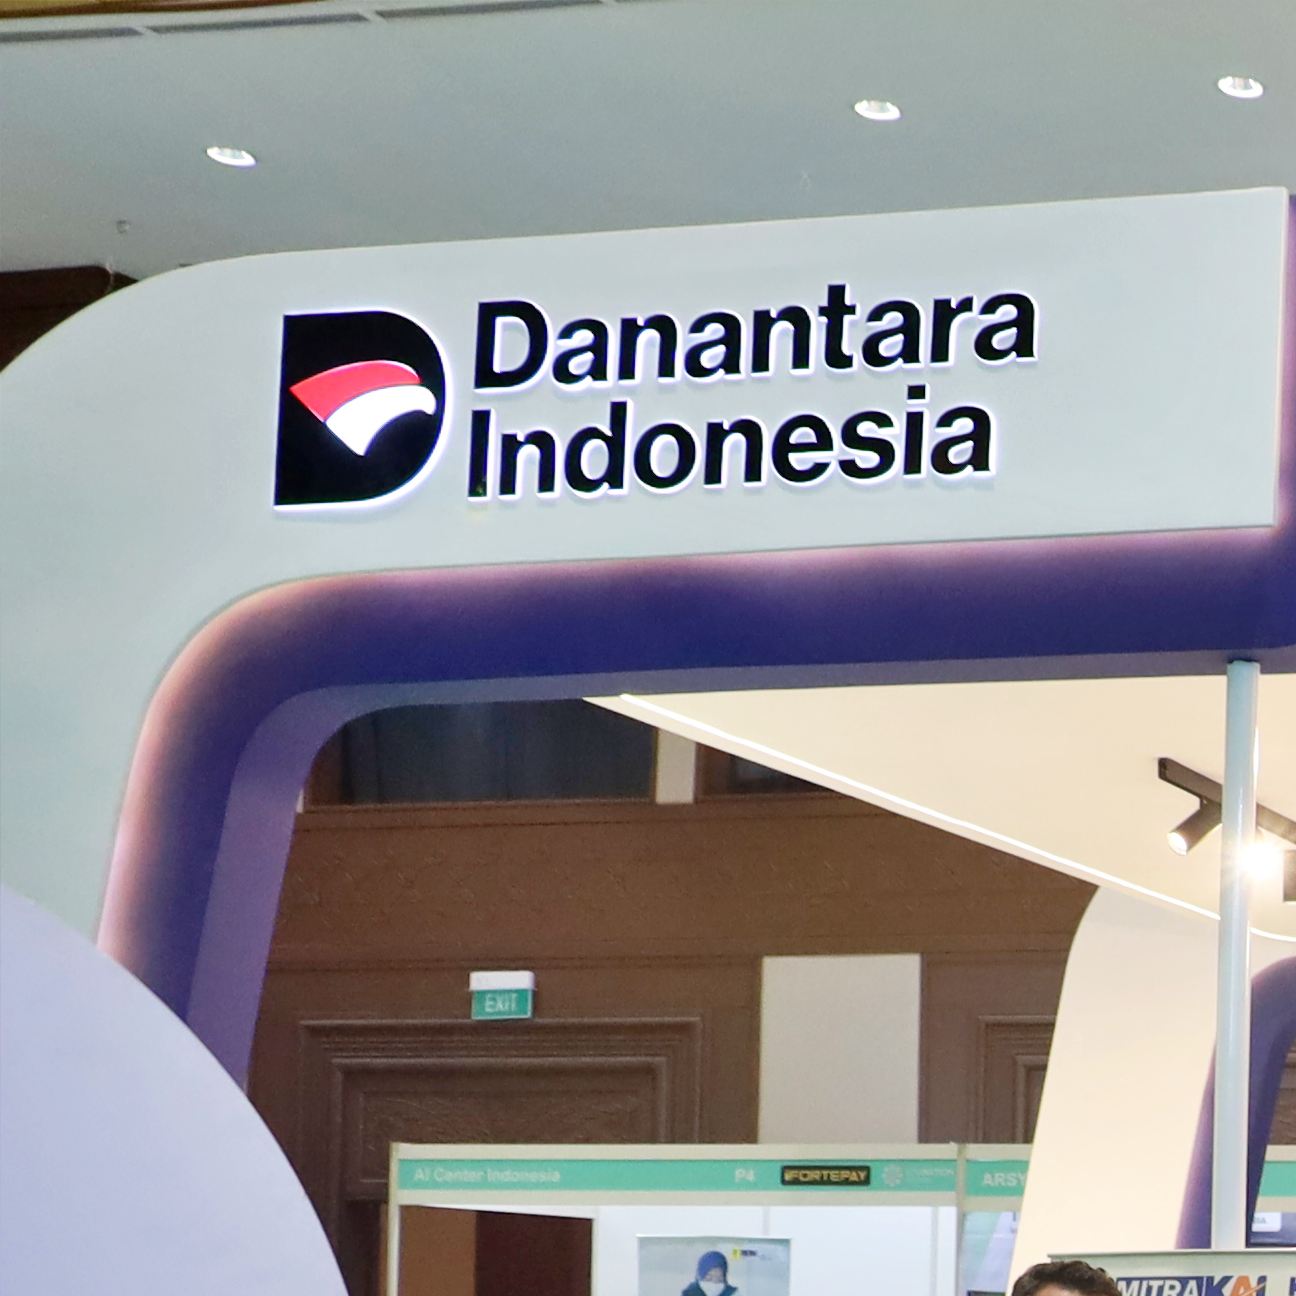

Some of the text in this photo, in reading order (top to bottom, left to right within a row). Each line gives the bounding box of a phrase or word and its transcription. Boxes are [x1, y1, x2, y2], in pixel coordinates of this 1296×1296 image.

[473, 283, 1037, 389] Danantara
[468, 385, 993, 498] Indonesia
[484, 993, 518, 1012] EXIT
[434, 1168, 485, 1182] Center
[487, 1168, 560, 1183] Indonesia
[734, 1168, 755, 1182] P4
